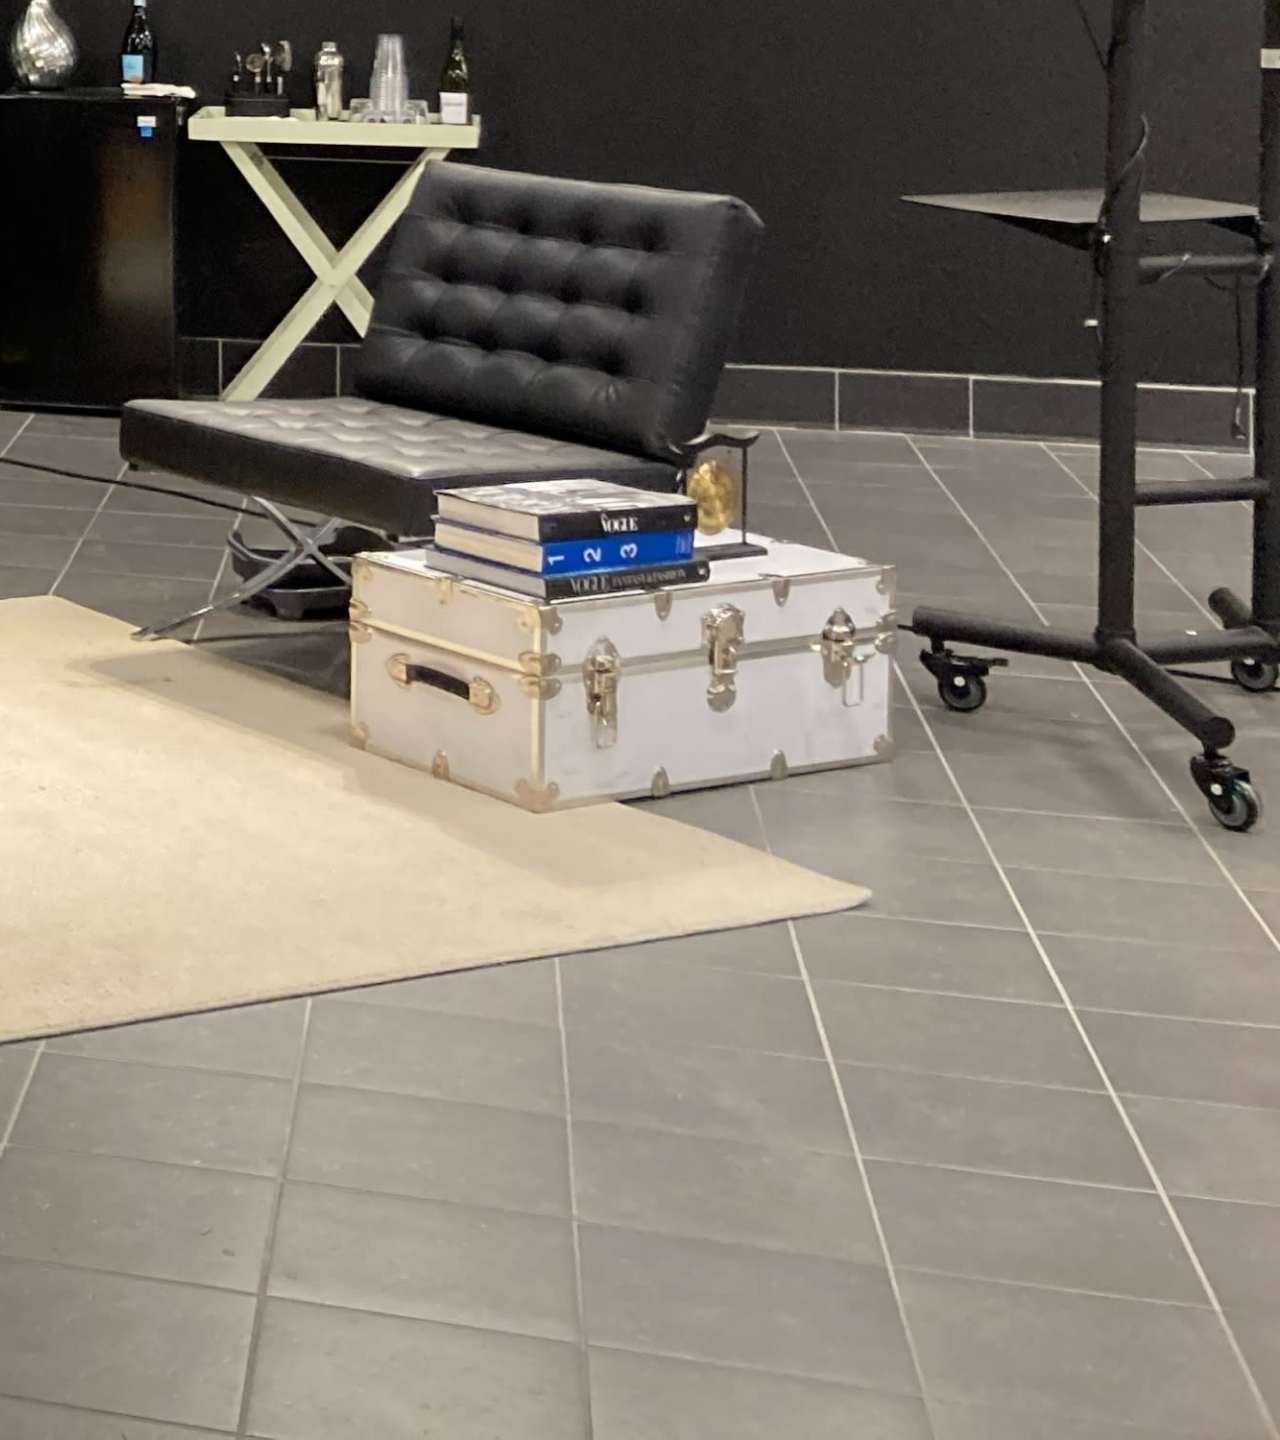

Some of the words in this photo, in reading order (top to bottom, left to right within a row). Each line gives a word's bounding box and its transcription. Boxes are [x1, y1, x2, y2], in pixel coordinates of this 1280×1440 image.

[601, 517, 638, 533] VOGUE
[547, 553, 565, 566] 1
[583, 546, 602, 562] 2
[620, 543, 638, 559] 3
